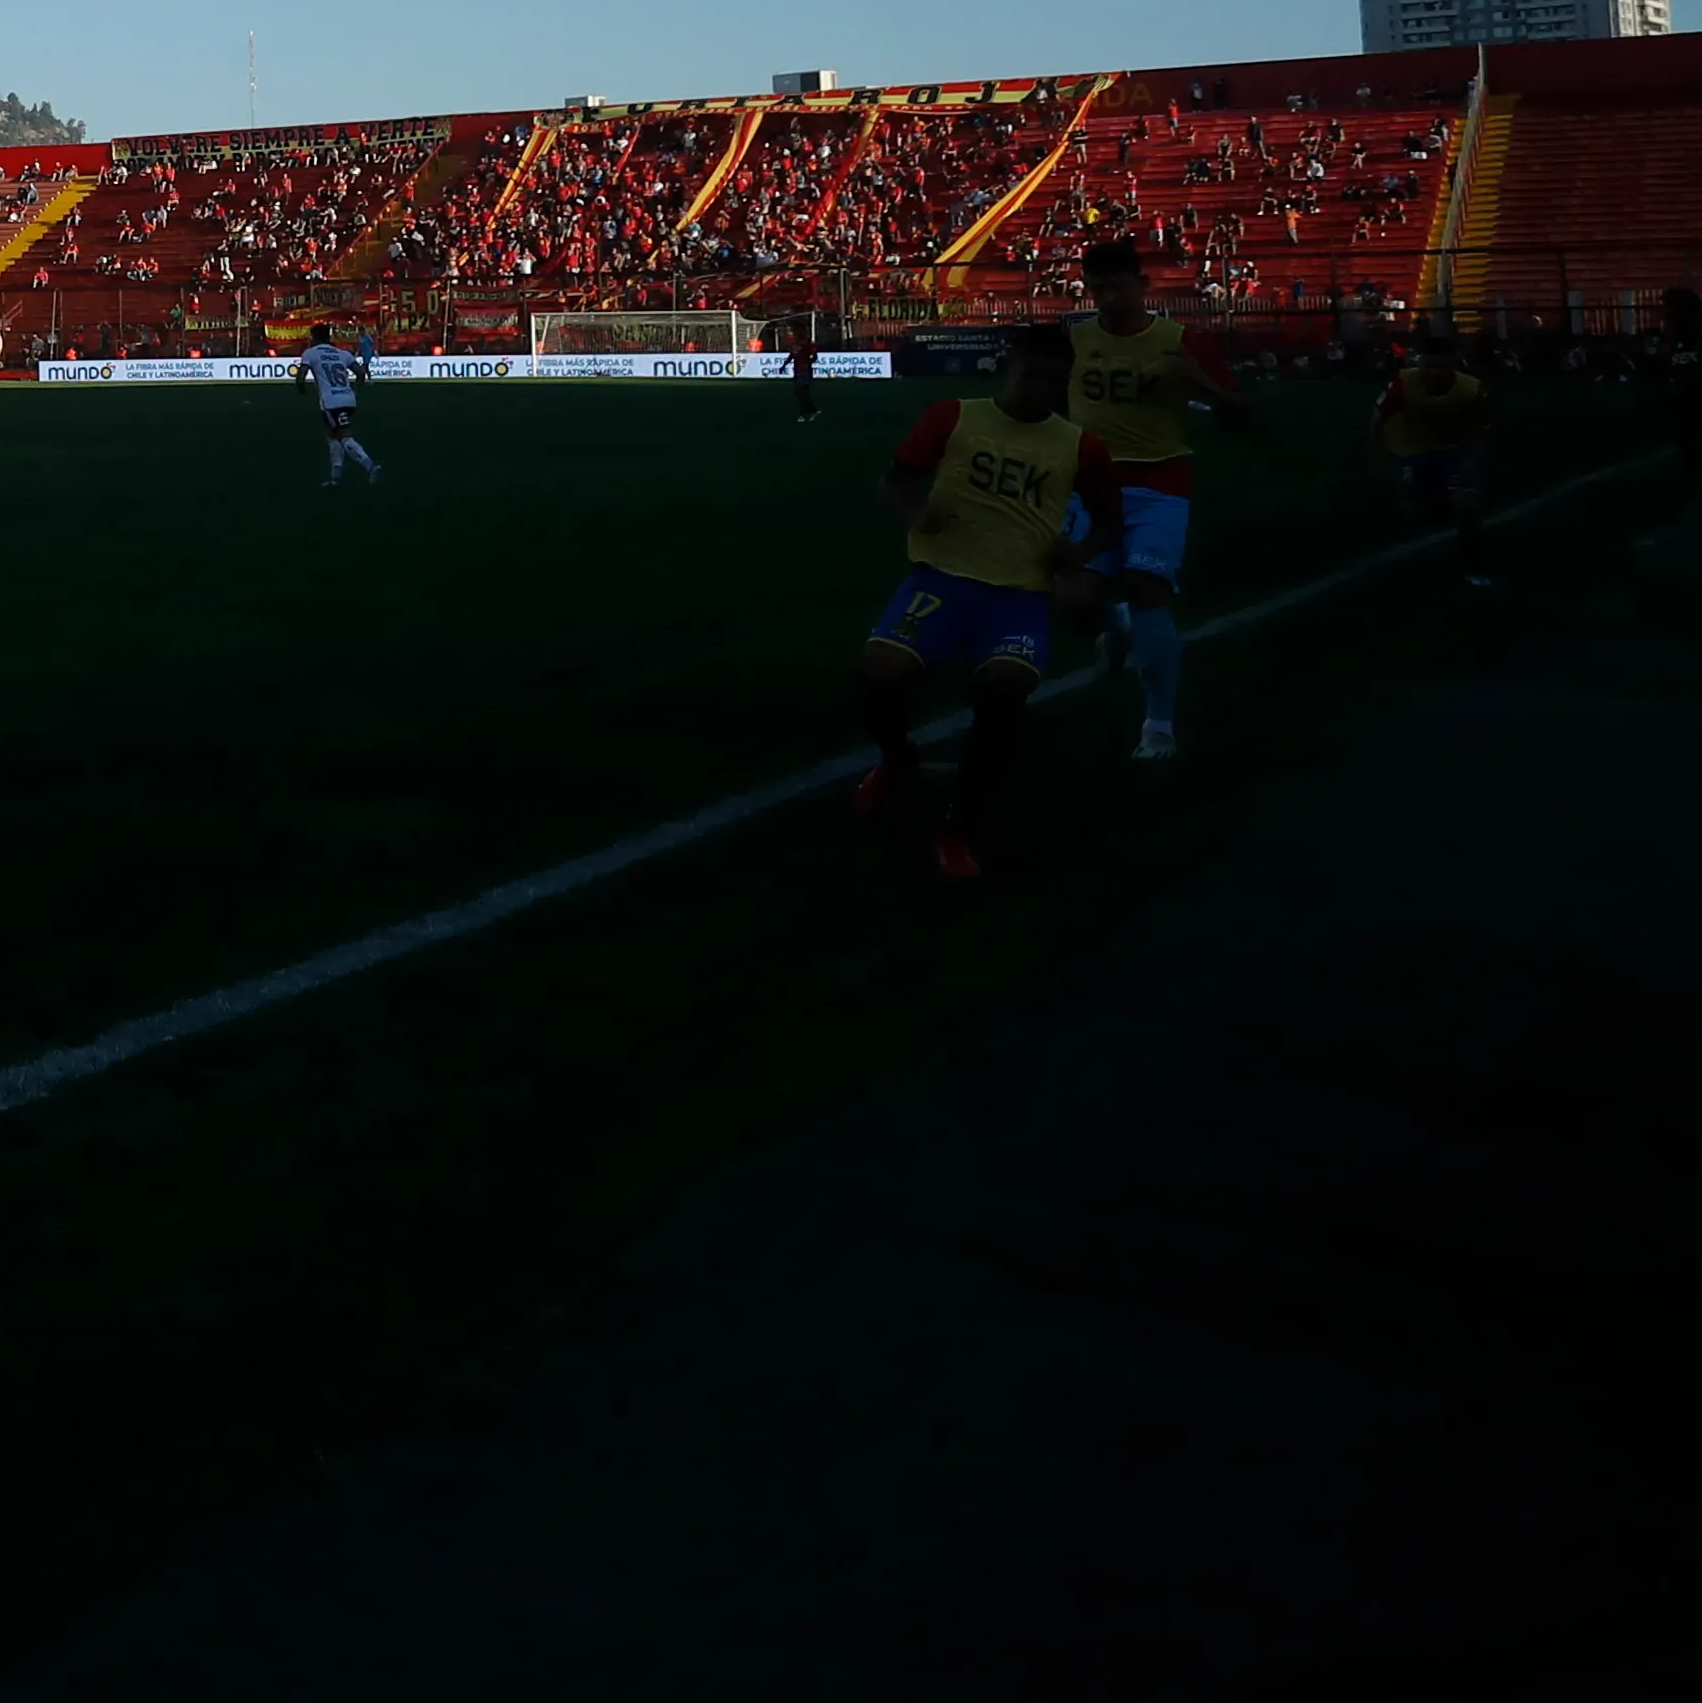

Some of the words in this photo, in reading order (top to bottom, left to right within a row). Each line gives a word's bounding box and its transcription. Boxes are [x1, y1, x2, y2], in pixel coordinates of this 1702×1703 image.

[829, 356, 866, 365] RÁPIDA
[868, 357, 883, 365] DE
[1082, 369, 1161, 405] SEK
[969, 451, 1051, 507] SEK
